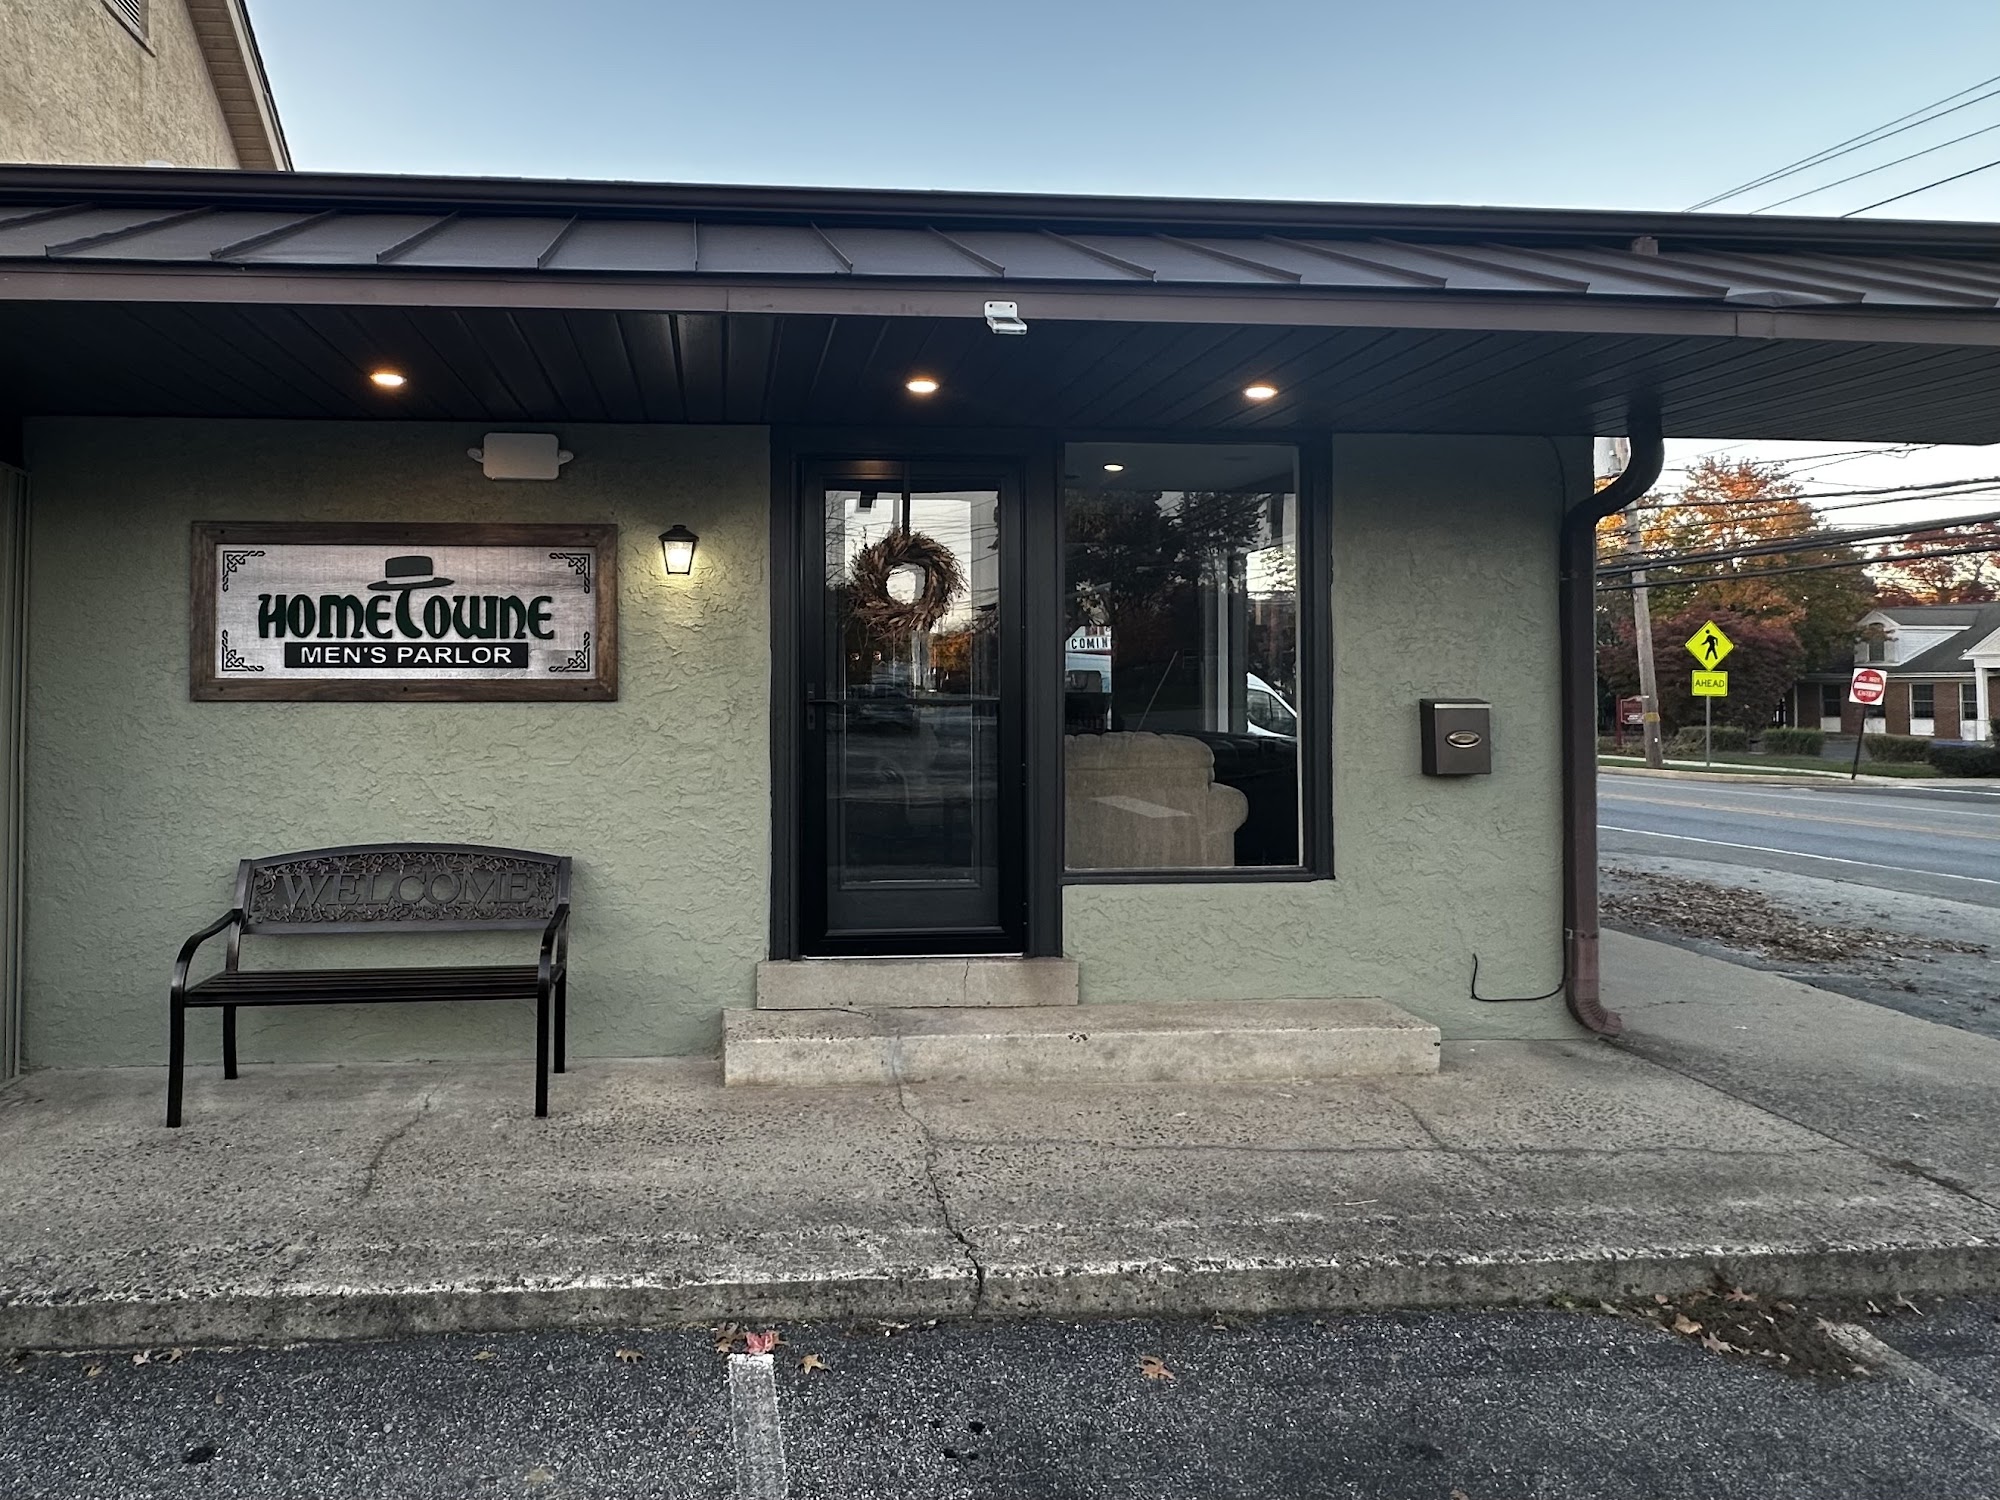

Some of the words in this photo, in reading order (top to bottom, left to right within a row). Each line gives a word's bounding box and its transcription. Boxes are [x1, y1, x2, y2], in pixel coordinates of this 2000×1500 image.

[300, 646, 387, 664] MEN'S
[397, 646, 512, 664] PARLOR
[1694, 679, 1725, 688] AHEAD
[277, 870, 531, 907] WELCOME
